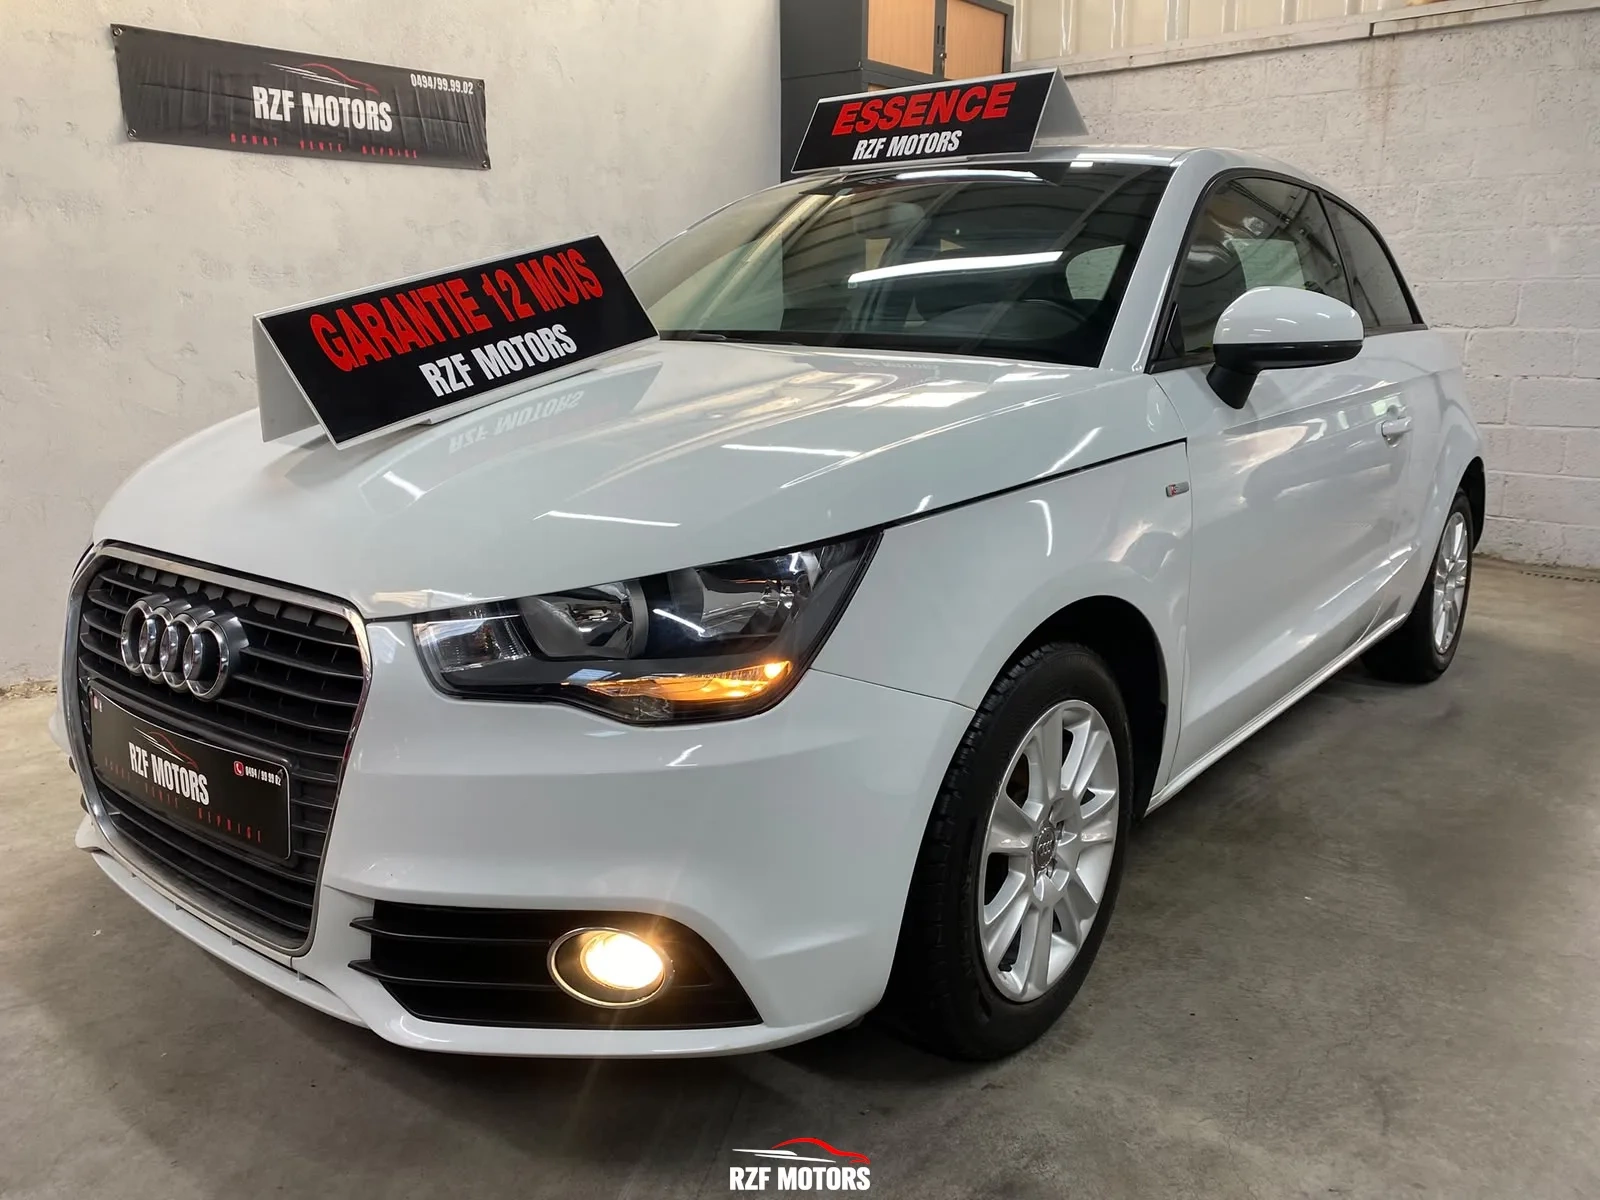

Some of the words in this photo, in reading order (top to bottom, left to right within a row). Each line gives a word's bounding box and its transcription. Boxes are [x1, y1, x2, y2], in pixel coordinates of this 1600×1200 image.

[252, 85, 295, 122] RZF
[303, 92, 393, 132] MOTORS
[410, 73, 474, 95] 0494/99.99.02
[831, 82, 1017, 136] ESSENCE
[852, 138, 887, 161] RZF
[886, 130, 962, 158] MOTORS
[310, 277, 492, 372] GARANTIE
[481, 268, 535, 323] 12
[515, 247, 603, 311] MOIS
[418, 353, 479, 398] RZF
[470, 323, 577, 381] MOTORS
[128, 741, 149, 779] RZF
[150, 753, 210, 806] MOTORS
